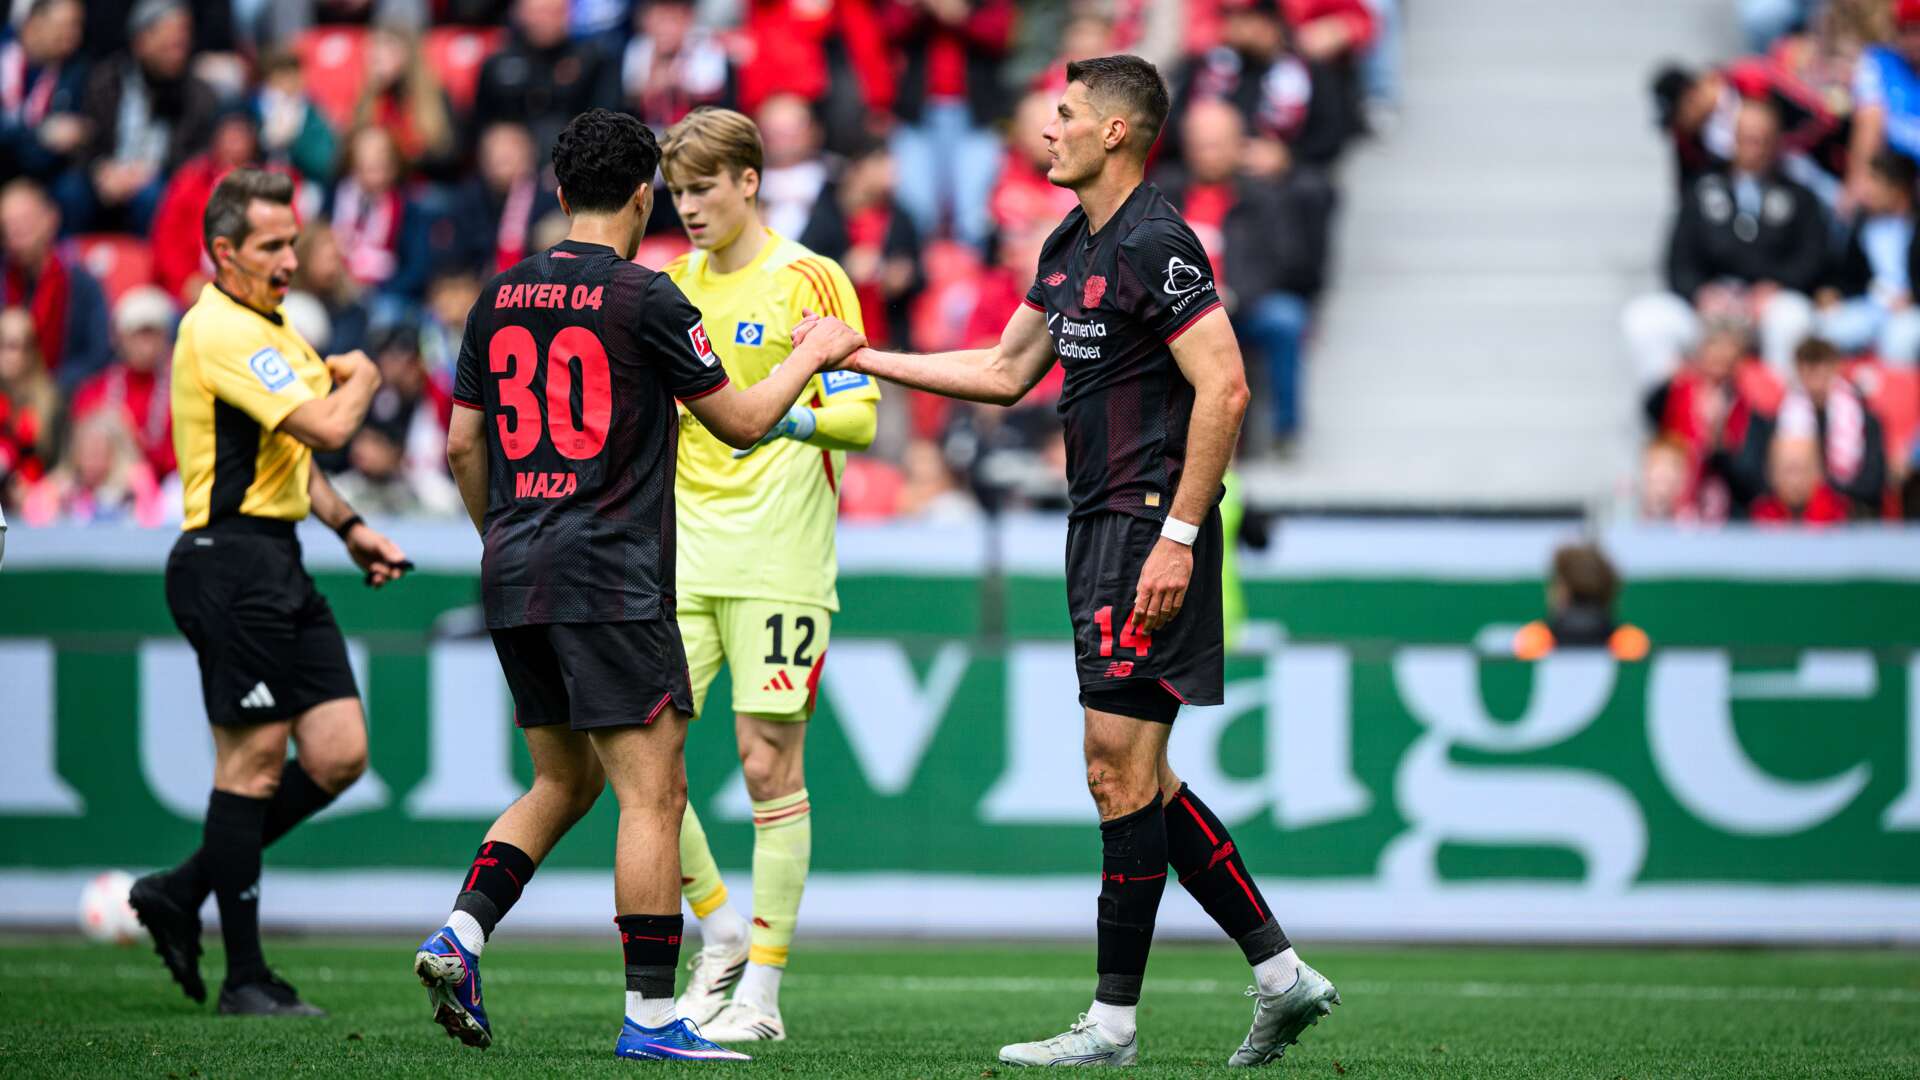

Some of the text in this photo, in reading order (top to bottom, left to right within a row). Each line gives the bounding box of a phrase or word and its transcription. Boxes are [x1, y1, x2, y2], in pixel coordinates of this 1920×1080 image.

[495, 283, 604, 311] BAYER 04
[1061, 316, 1107, 338] Barmenia
[1058, 337, 1101, 360] Gothaer
[489, 325, 612, 460] 30
[515, 471, 577, 499] MAZA
[764, 613, 815, 667] 12
[1094, 605, 1152, 657] 14
